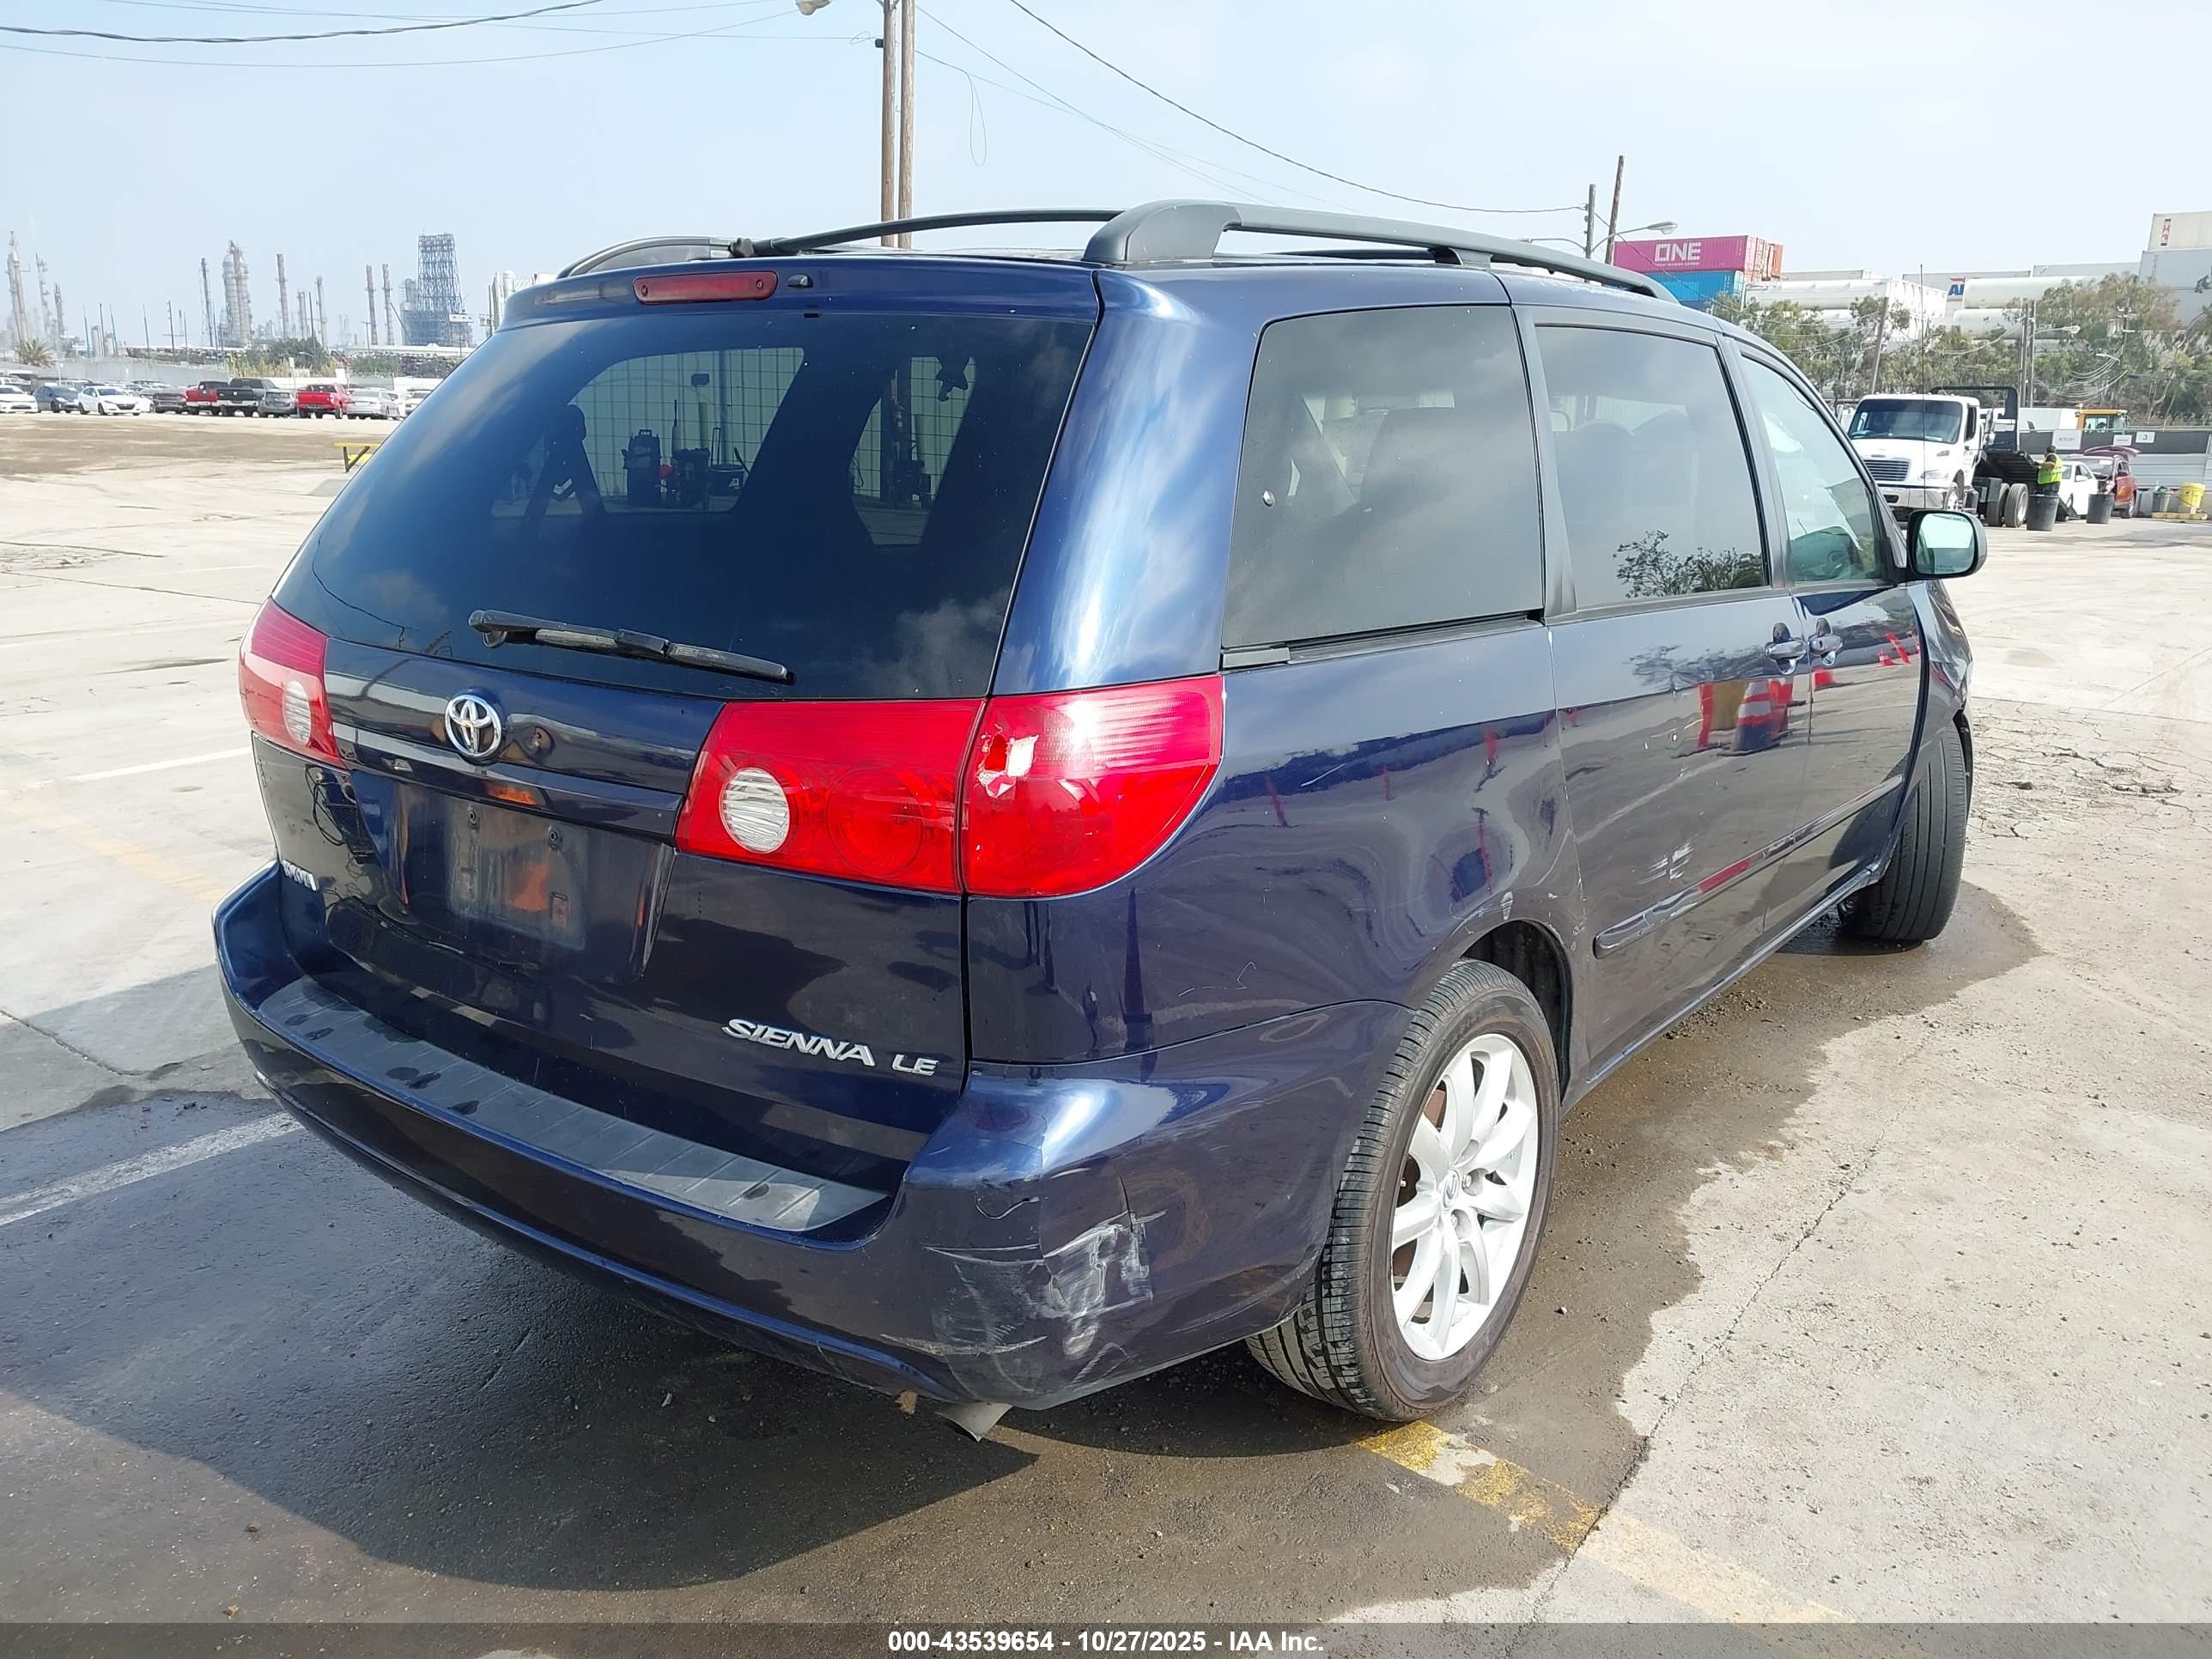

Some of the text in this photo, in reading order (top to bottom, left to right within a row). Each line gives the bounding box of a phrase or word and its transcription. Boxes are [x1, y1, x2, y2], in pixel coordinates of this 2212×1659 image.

[1655, 242, 1701, 262] ONE
[721, 1018, 939, 1076] SIENNA LE
